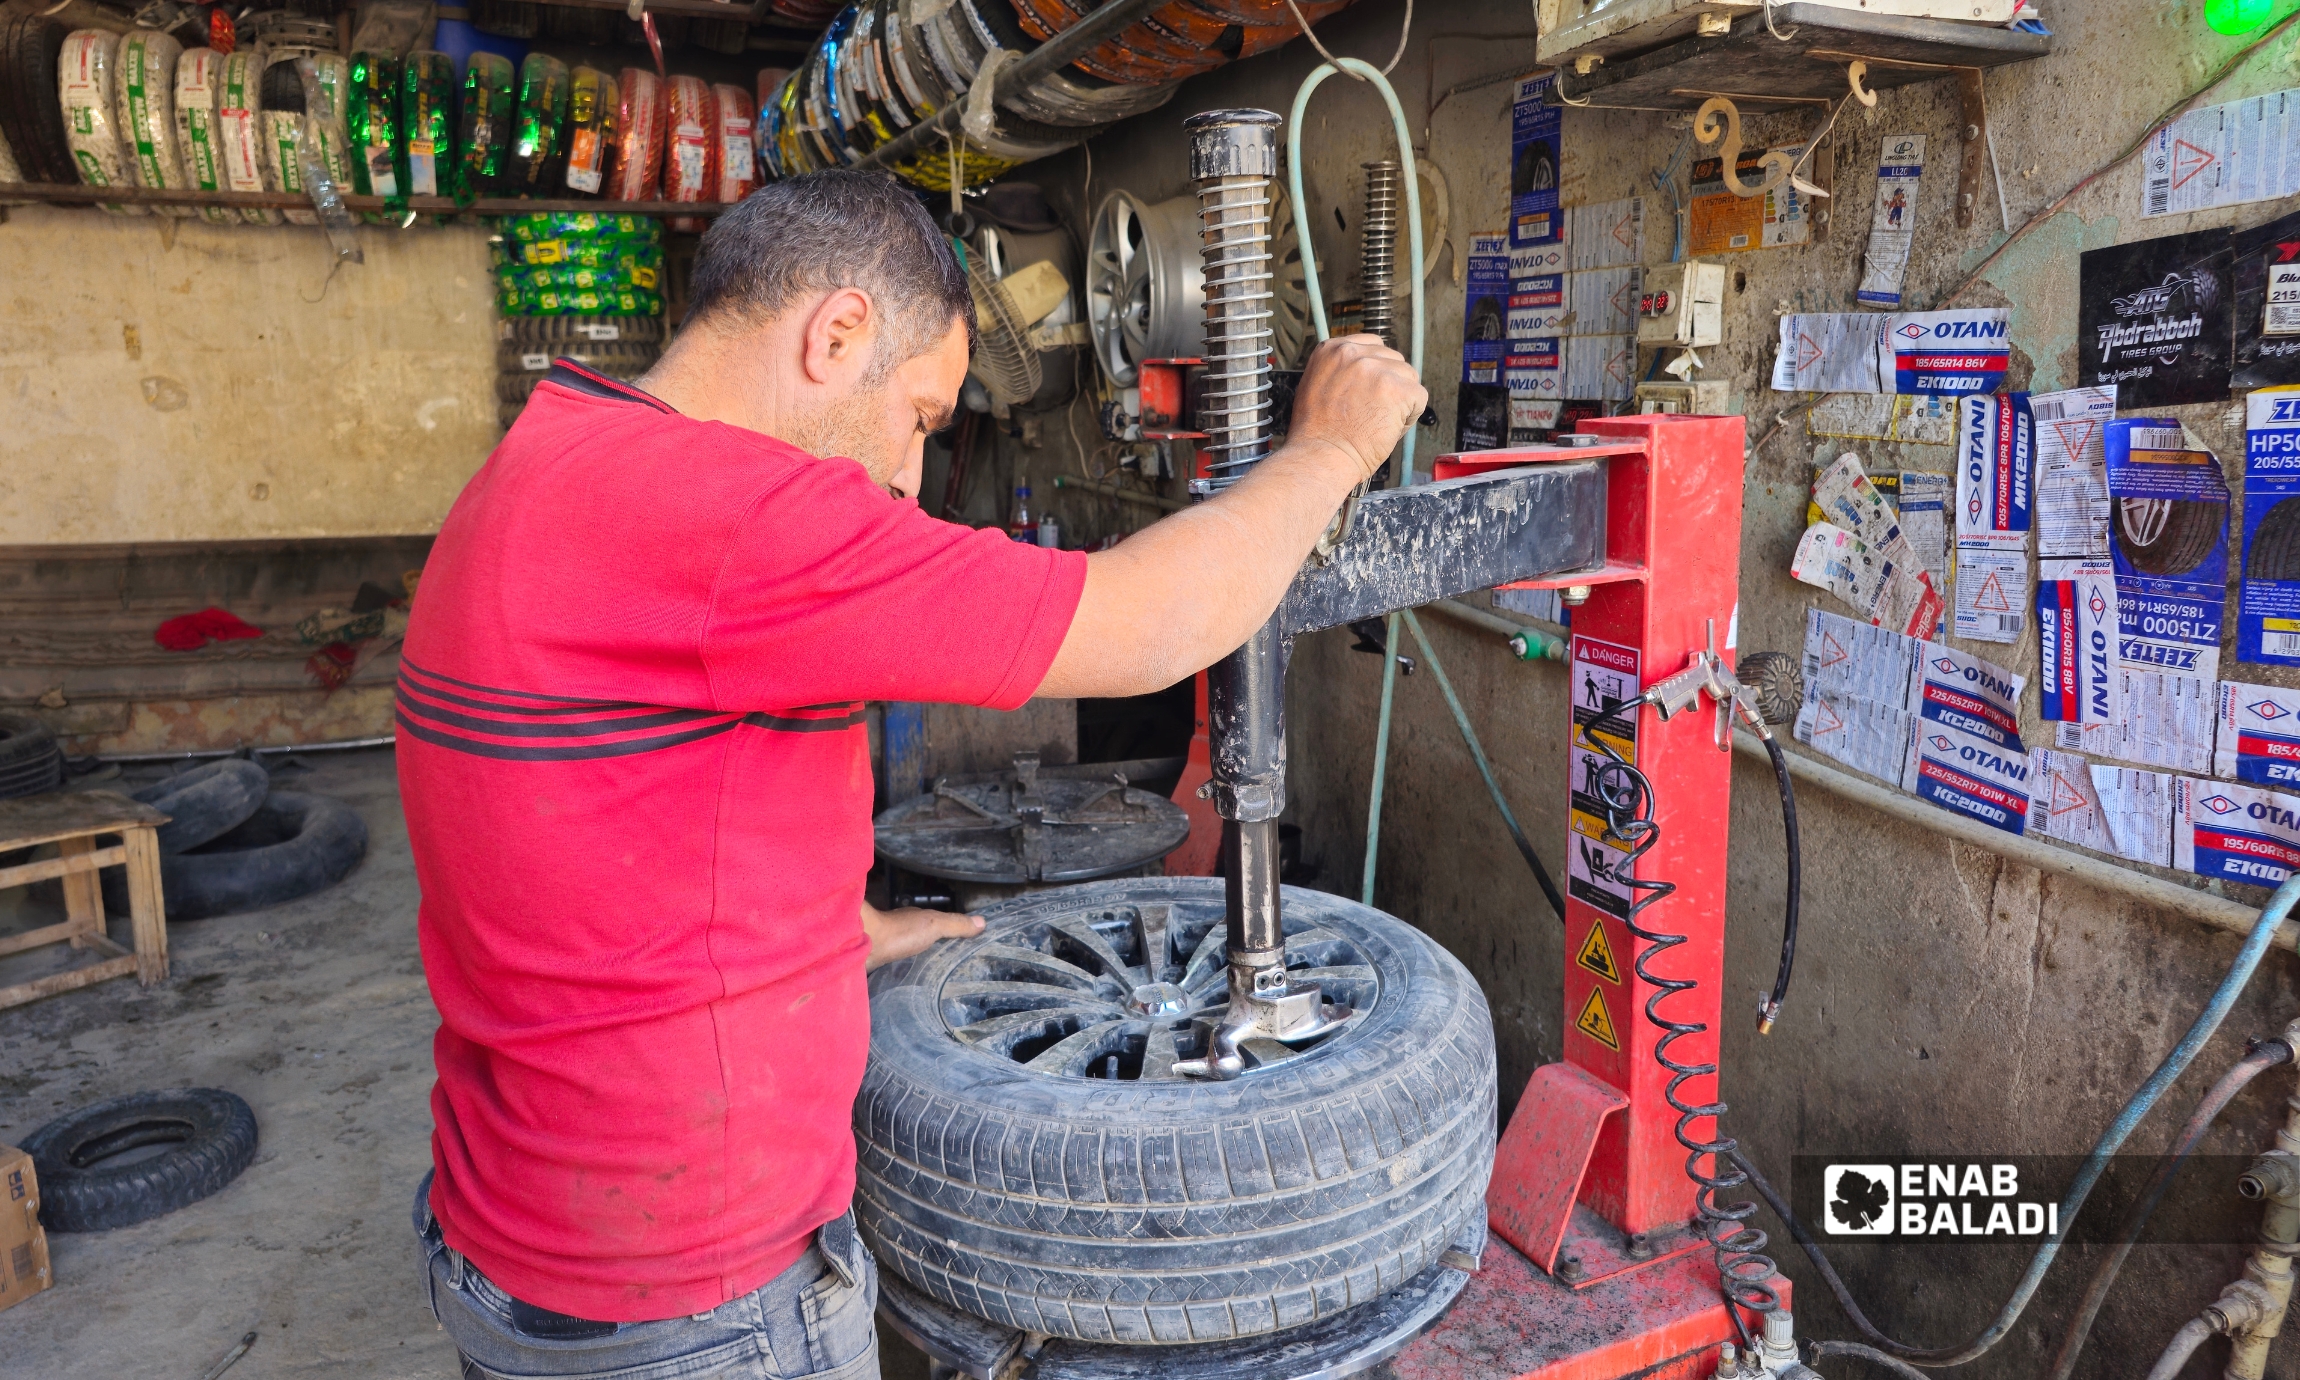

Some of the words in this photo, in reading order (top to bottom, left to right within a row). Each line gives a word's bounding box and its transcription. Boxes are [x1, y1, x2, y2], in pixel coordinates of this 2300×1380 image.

[1510, 254, 1543, 270] OTANI
[1516, 279, 1553, 292] KC2000
[1510, 318, 1542, 330] OTANI
[1934, 321, 2005, 339] OTANI
[1514, 342, 1550, 352] KC2000
[2097, 312, 2203, 363] Abdrabboh
[1915, 358, 1964, 368] 185/65R14
[1964, 358, 1988, 368] 86V
[2120, 348, 2147, 359] TIRES
[2149, 344, 2183, 356] GROUP
[1506, 378, 1538, 390] OTANI
[1917, 376, 1984, 390] EK1000
[1970, 400, 1986, 482] OTANI
[2000, 444, 2009, 465] 8PR
[2014, 412, 2029, 510] MK2000
[1998, 466, 2008, 528] 205/70R15C
[2138, 600, 2205, 618] 185/65R14
[2062, 608, 2073, 667] 195/60R15
[2144, 617, 2216, 640] ZT5000
[1592, 648, 1634, 668] DANGER
[2042, 608, 2056, 694] EK1000
[1963, 666, 2015, 702] OTANI
[2063, 668, 2073, 694] 88V
[2091, 630, 2109, 718] OTANI
[1930, 689, 1984, 713] 225/55ZR17
[1938, 709, 2005, 744] KC2000
[1960, 746, 2028, 782] OTANI
[1926, 765, 1978, 792] 225/55ZR17
[1979, 788, 2005, 803] 101W
[2006, 797, 2018, 810] XL
[1933, 785, 2007, 824] KC2000
[2247, 802, 2300, 829] OTA
[2223, 837, 2284, 858] 195/60R15
[2285, 851, 2300, 863] 88
